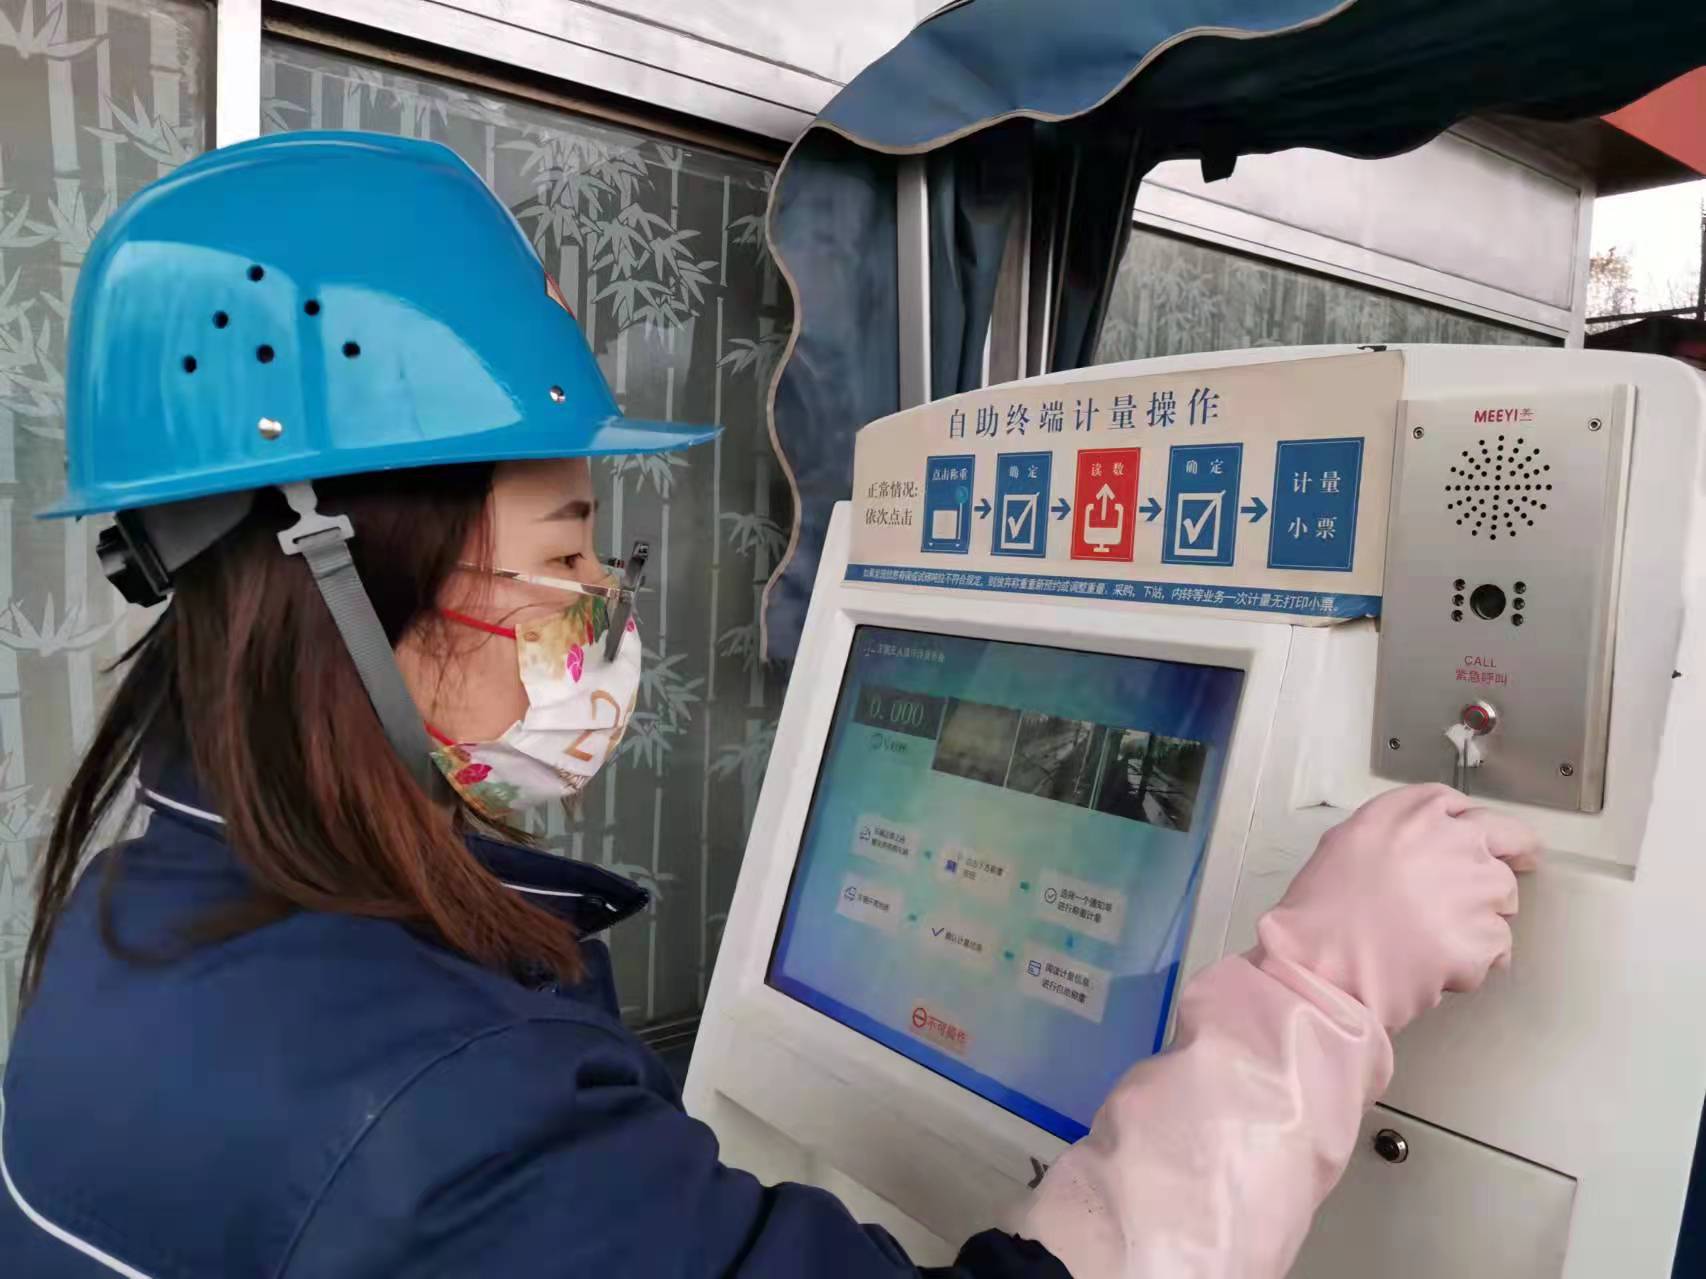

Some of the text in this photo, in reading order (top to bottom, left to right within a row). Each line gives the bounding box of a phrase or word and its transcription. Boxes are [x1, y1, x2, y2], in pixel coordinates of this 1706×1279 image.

[950, 387, 1221, 439] 自助终端计量操作
[1474, 408, 1519, 423] MEEYI
[932, 467, 968, 481] 点击称重
[1185, 458, 1224, 474] 确定
[1294, 471, 1341, 493] 计量
[865, 508, 912, 526] 依次点击
[1288, 516, 1337, 539] 小票
[1464, 655, 1497, 668] CALL
